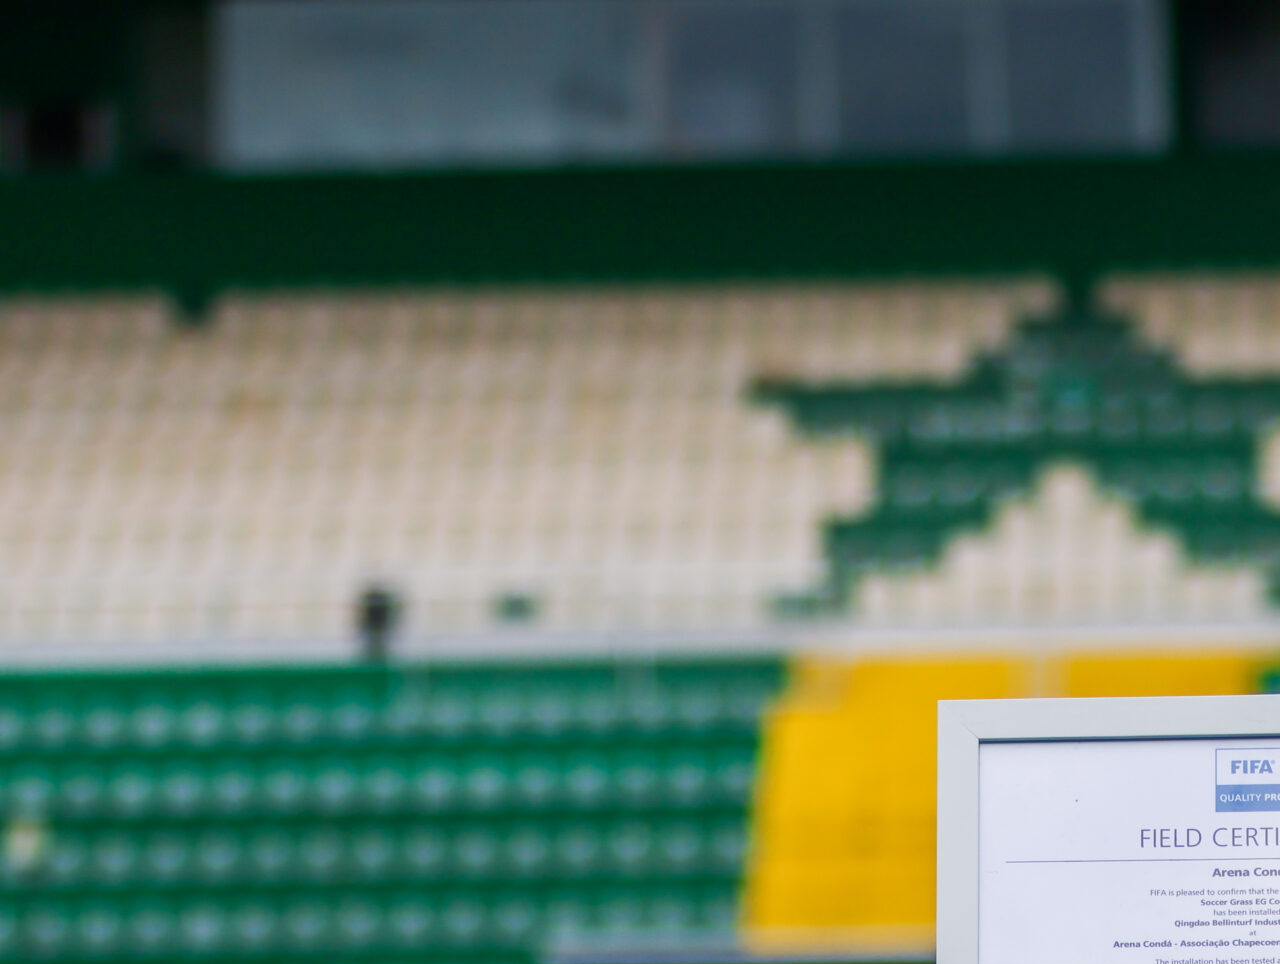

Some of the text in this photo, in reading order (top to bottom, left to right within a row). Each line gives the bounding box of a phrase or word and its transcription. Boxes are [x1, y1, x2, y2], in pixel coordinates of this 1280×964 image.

[1219, 793, 1261, 803] QUALITY
[1140, 827, 1203, 849] FIELD
[1212, 866, 1250, 878] Arena
[1150, 888, 1167, 897] FIFA
[1168, 888, 1175, 897] is
[1175, 888, 1206, 897] pleased
[1216, 888, 1247, 896] confirm
[1247, 887, 1265, 896] that
[1265, 887, 1280, 895] the
[1199, 898, 1229, 907] Soccer
[1229, 897, 1254, 906] Grass
[1254, 897, 1268, 905] EG
[1212, 908, 1227, 917] has
[1173, 919, 1211, 929] Qingdao
[1211, 918, 1254, 927] Bellinturf
[1112, 940, 1142, 949] Arena
[1142, 938, 1173, 949] Condá
[1179, 939, 1231, 949] Associação
[1171, 957, 1214, 964] installation
[1229, 956, 1250, 964] been
[1250, 956, 1277, 964] tested
